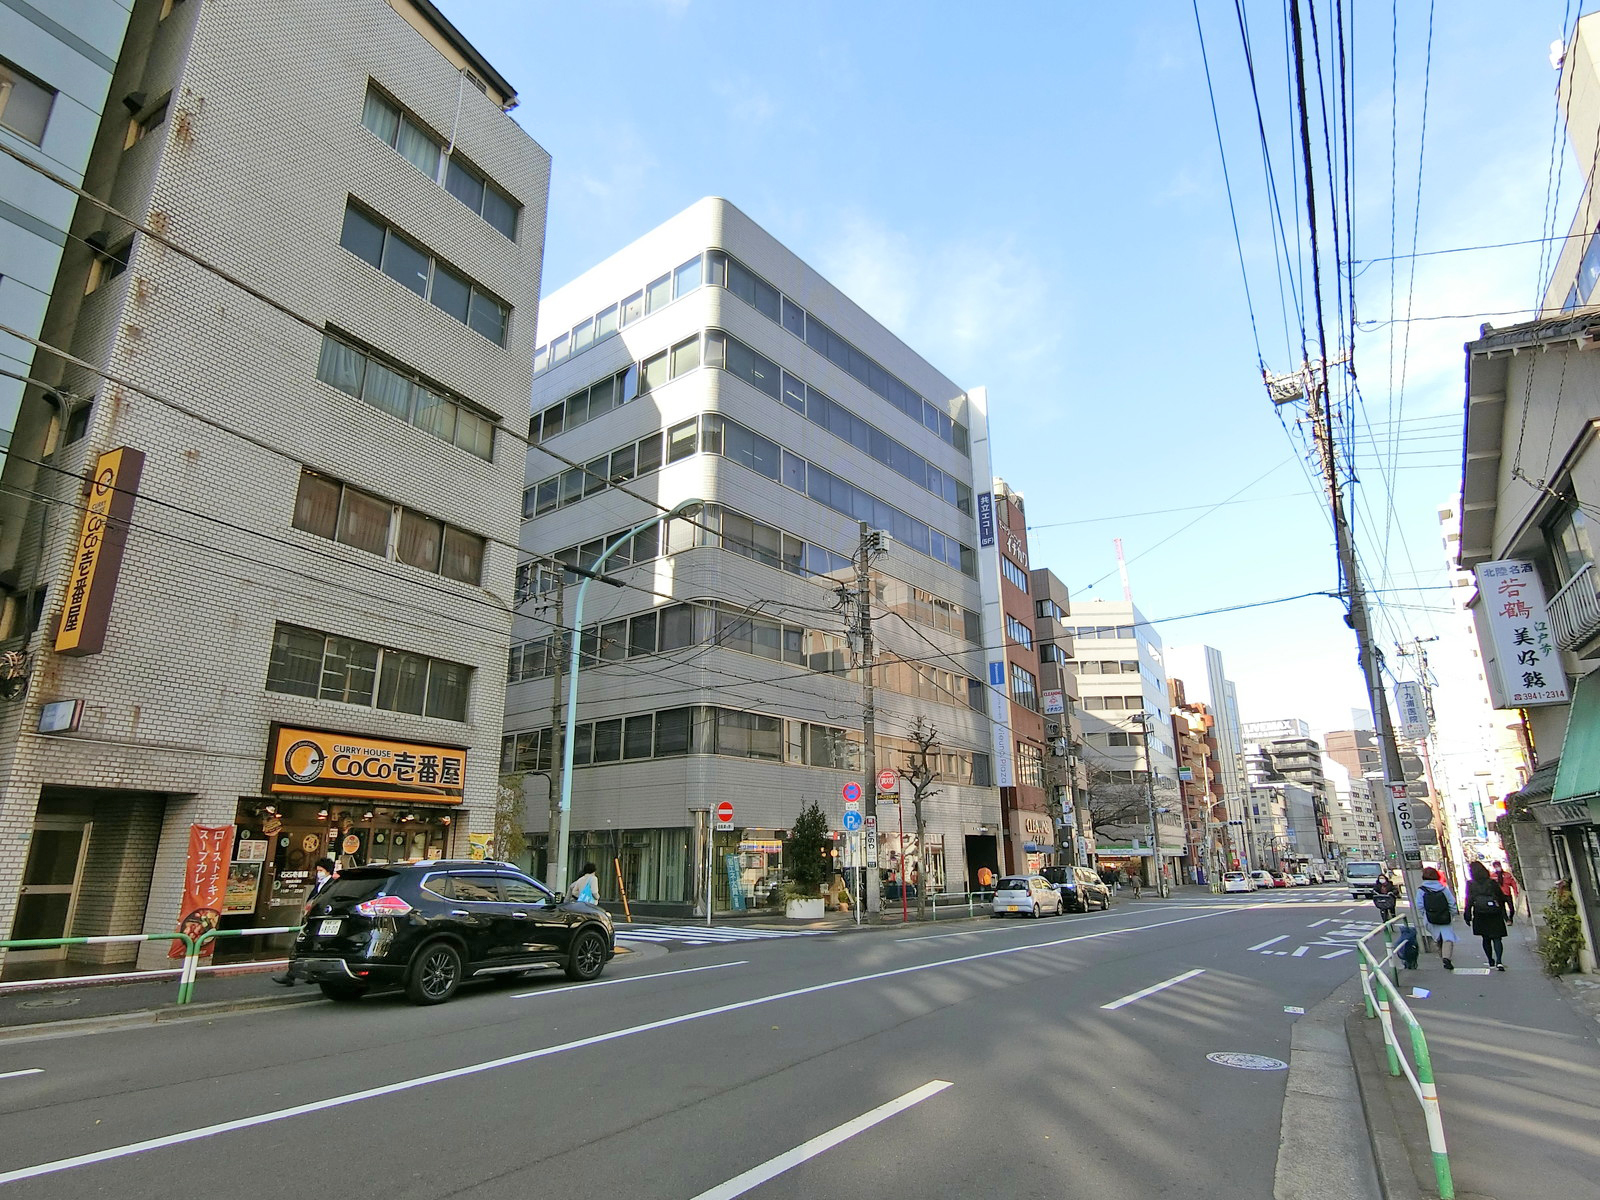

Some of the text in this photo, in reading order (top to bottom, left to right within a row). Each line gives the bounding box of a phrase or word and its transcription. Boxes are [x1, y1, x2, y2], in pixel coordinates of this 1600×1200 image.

[980, 496, 990, 536] 共立エコー
[981, 537, 994, 546] (5F)
[1483, 562, 1534, 578] 北陸名酒
[1498, 578, 1533, 620] 若鶴
[1523, 690, 1565, 701] 3941-2314
[333, 744, 391, 758] CURRY HOUSE
[331, 751, 461, 786] CoCo壱番屋
[847, 816, 855, 829] P
[1397, 802, 1413, 831] さのや
[195, 829, 209, 896] スープカレー
[207, 830, 225, 906] ローストチキン
